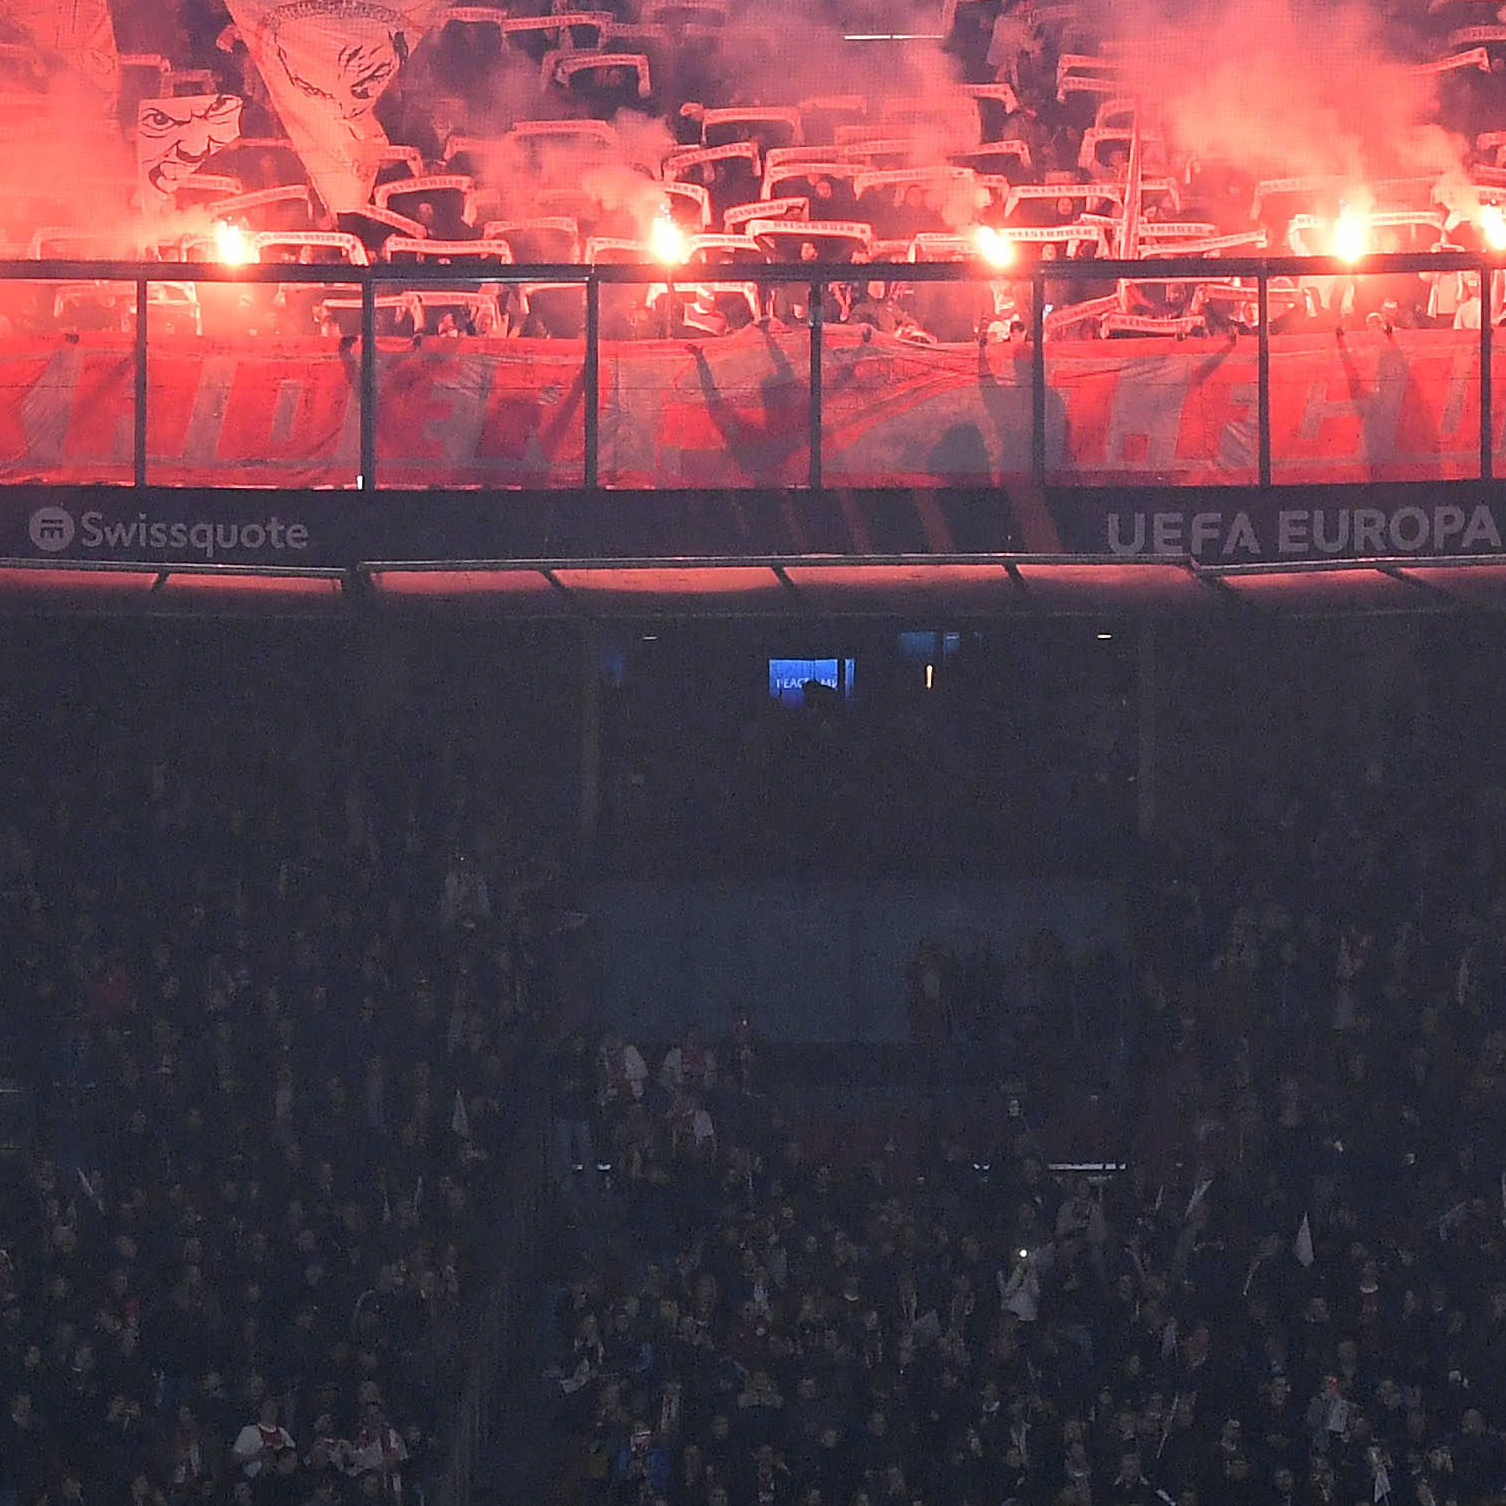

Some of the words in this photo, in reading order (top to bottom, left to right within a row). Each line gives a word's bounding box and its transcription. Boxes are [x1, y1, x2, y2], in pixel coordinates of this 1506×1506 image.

[81, 511, 310, 557] Swissquote
[1107, 510, 1261, 556] UEFA
[1278, 505, 1502, 554] EUROPA
